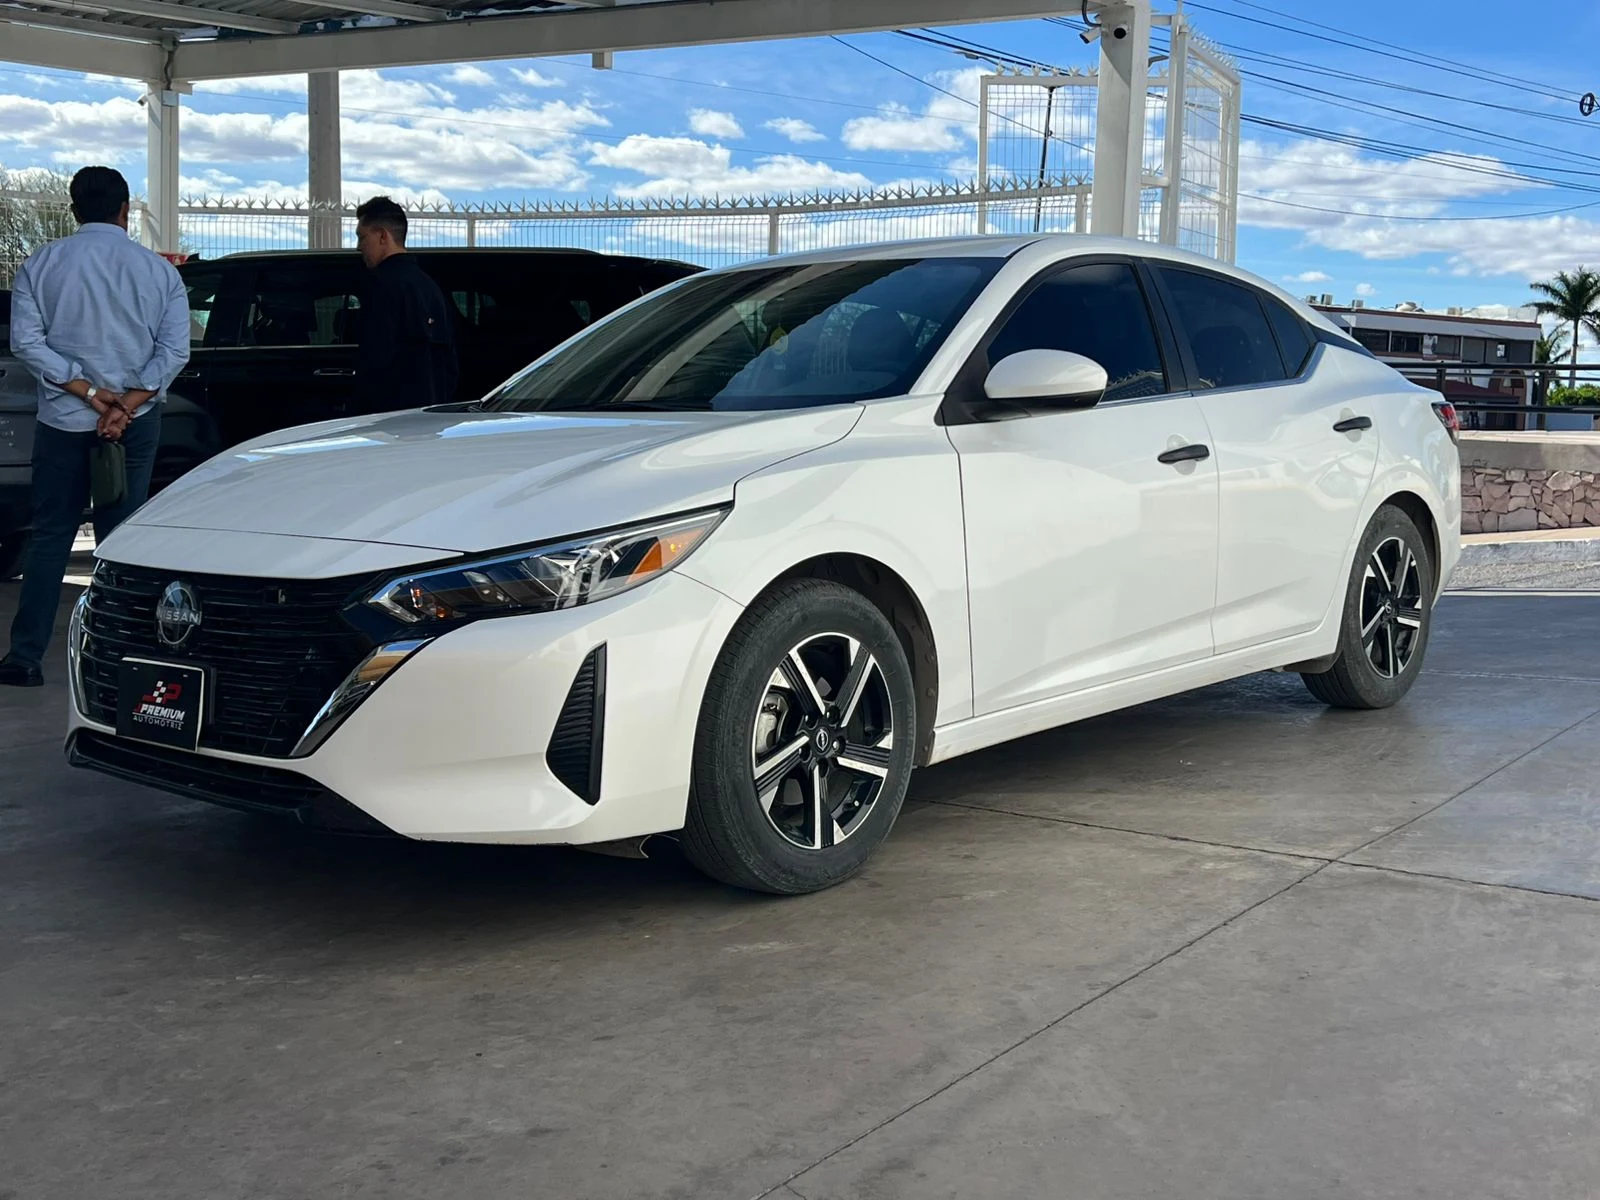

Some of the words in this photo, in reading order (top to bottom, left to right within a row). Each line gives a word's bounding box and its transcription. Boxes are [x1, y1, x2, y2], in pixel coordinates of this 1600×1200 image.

[158, 609, 199, 623] NISSAN
[140, 703, 186, 721] PREMIUM
[132, 714, 183, 731] AUTOMOTRIZ
